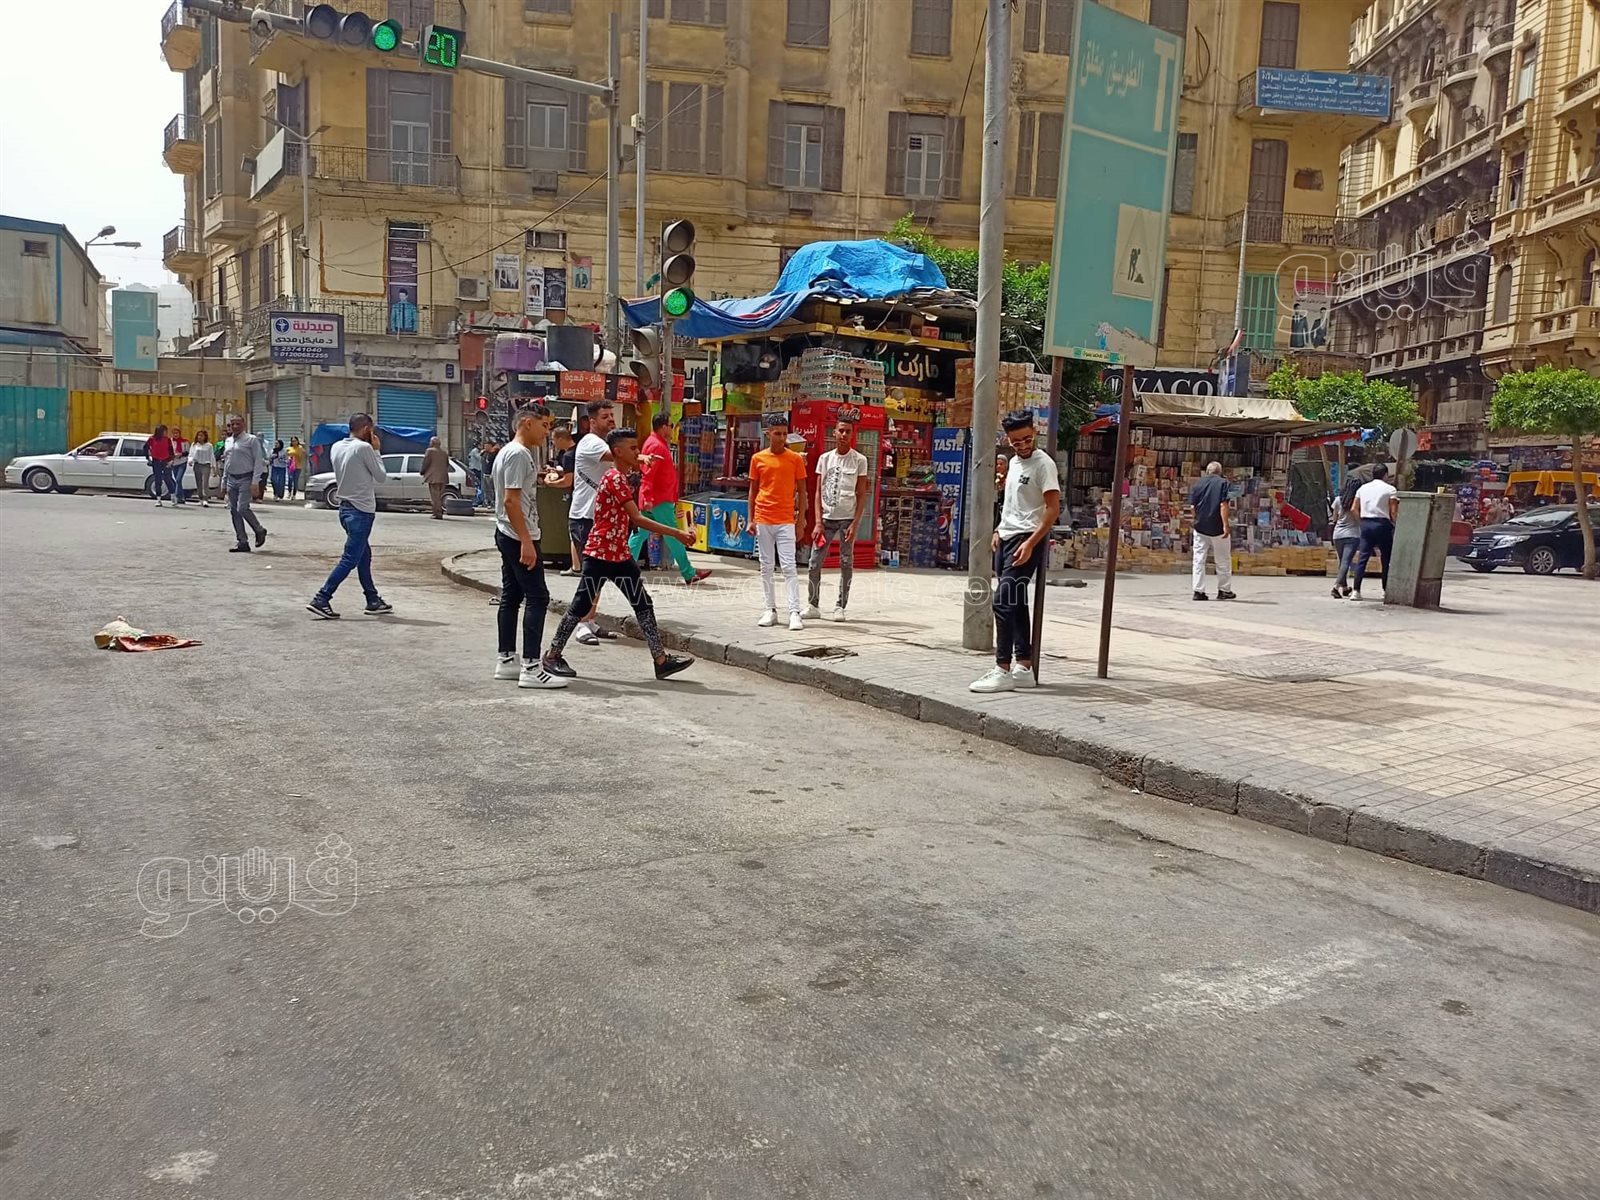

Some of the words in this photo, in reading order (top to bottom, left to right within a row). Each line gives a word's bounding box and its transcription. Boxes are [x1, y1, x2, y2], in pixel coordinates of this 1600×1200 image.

[425, 31, 457, 67] 20
[1080, 40, 1104, 87] مغلق
[1105, 49, 1145, 96] الطريق
[293, 320, 334, 334] صيدلية
[275, 336, 298, 344] مجدى
[299, 336, 325, 344] مايكل
[897, 351, 941, 382] ماركت
[564, 373, 584, 384] قهوة
[588, 374, 602, 384] شاي
[560, 386, 585, 397] اندومي
[934, 439, 963, 451] TASTE
[933, 462, 961, 473] TASTE
